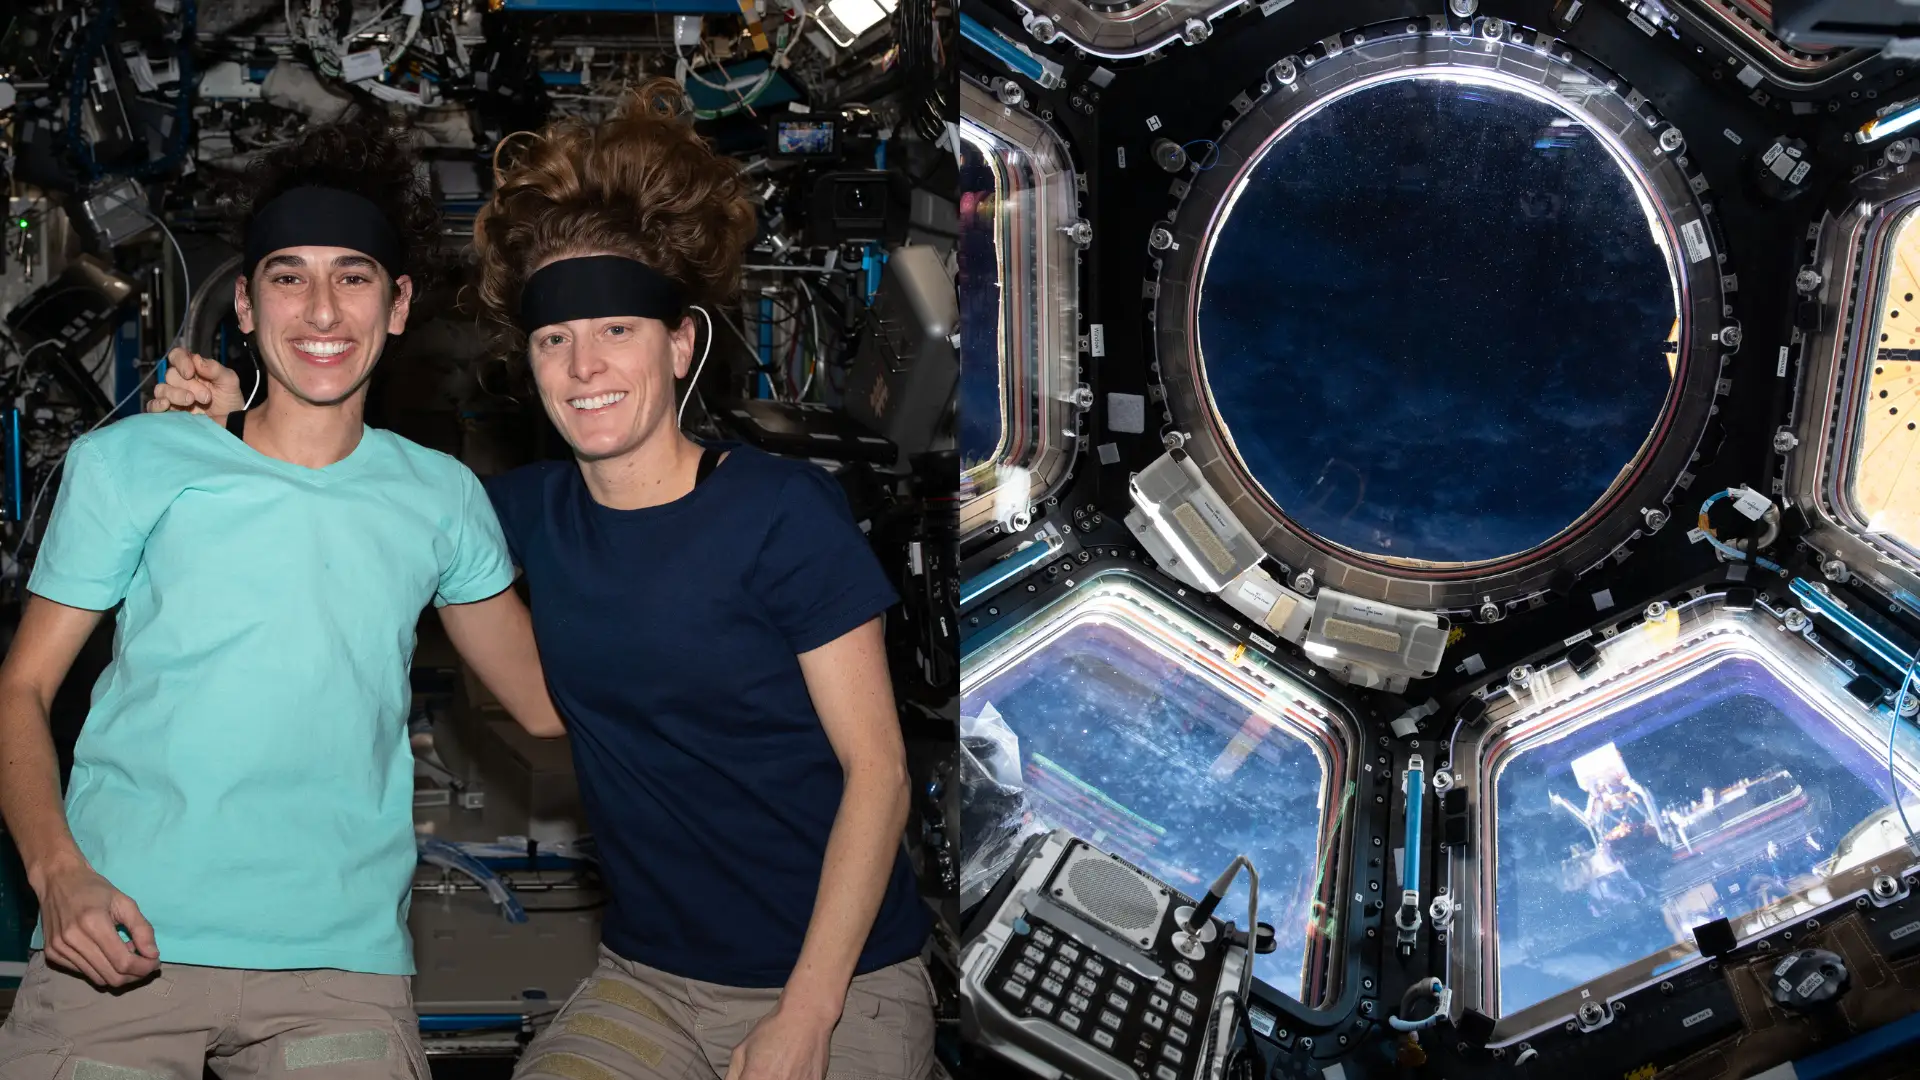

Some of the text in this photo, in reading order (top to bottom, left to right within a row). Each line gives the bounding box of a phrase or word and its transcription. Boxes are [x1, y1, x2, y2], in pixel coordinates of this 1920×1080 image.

[1632, 16, 1653, 34] Window
[1148, 116, 1160, 130] H
[1764, 145, 1779, 160] CLOSED
[1779, 351, 1787, 374] Window
[939, 616, 950, 638] Canon
[1251, 634, 1270, 649] Window
[1566, 633, 1586, 645] Window
[1116, 857, 1194, 905] AUDIO TERMINAL UNIT
[1177, 965, 1191, 976] PTT
[1802, 978, 1821, 995] CLOSED
